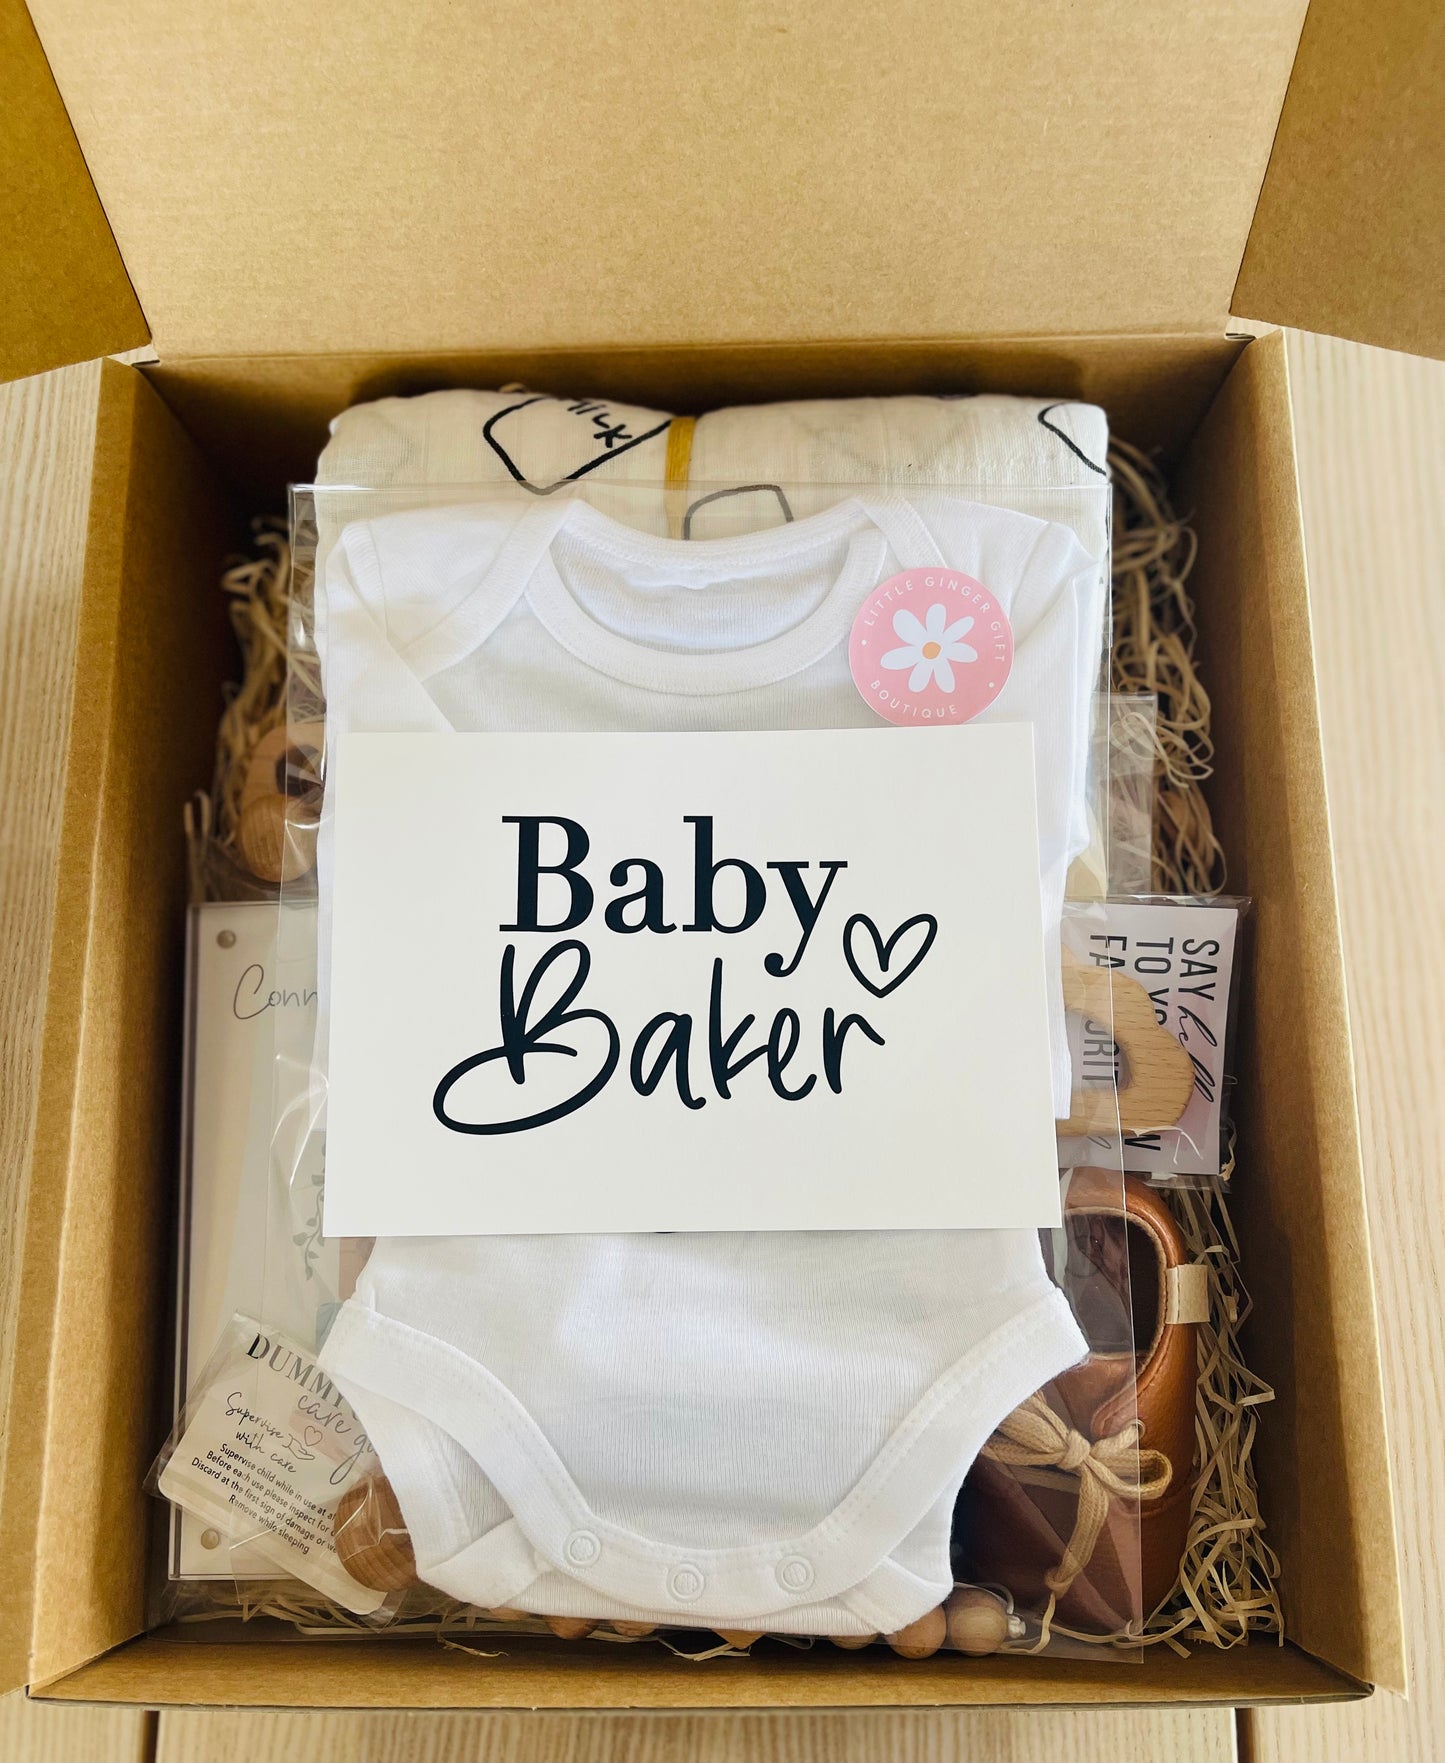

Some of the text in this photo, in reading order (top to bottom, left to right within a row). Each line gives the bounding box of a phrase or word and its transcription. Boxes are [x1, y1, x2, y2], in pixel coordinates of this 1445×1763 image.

[864, 576, 1006, 662] LITTLE GINGER GIFT
[870, 680, 959, 719] BOUTIQUE
[499, 815, 848, 978] Baby
[1134, 937, 1174, 974] TO
[432, 938, 886, 1136] Baker
[1177, 938, 1220, 1103] SAY hell
[225, 1391, 284, 1439] Supervise
[298, 1394, 352, 1434] care
[220, 1443, 256, 1471] Supervise
[257, 1466, 276, 1483] child
[275, 1479, 295, 1496] while
[295, 1491, 302, 1501] in
[303, 1498, 317, 1511] use
[317, 1505, 327, 1517] at
[235, 1431, 297, 1473] with care
[191, 1456, 221, 1480] Discard
[220, 1475, 231, 1487] at
[230, 1480, 244, 1494] the
[244, 1487, 260, 1505] first
[260, 1500, 276, 1516] sign
[276, 1509, 287, 1521] of
[285, 1517, 315, 1543] damage
[316, 1536, 329, 1547] or
[206, 1450, 232, 1471] Before
[232, 1468, 250, 1482] each
[251, 1479, 265, 1492] use
[264, 1488, 288, 1508] please
[288, 1503, 316, 1526] inspect
[316, 1519, 329, 1533] for
[228, 1493, 311, 1555] Remove while sleeping
